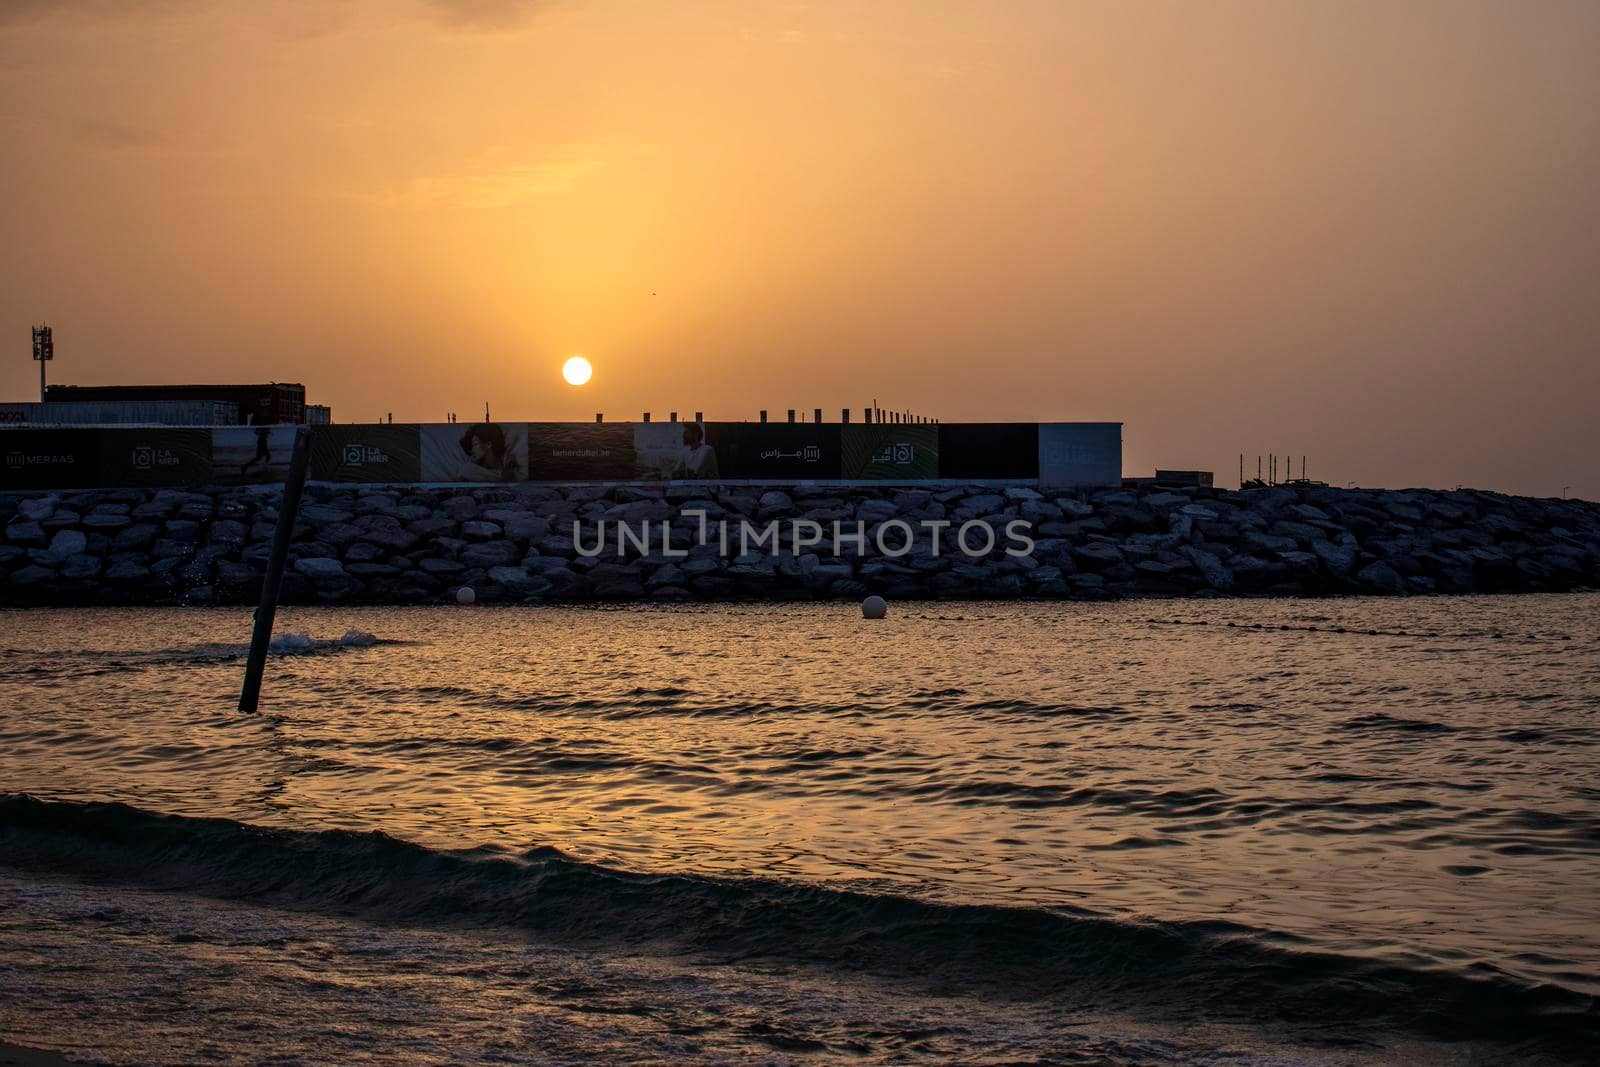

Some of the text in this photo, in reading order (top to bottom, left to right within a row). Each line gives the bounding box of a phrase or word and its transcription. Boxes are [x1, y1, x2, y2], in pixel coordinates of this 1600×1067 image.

[158, 449, 171, 457] LA
[367, 447, 380, 455] LA
[26, 455, 74, 465] MERAAS
[367, 455, 389, 463] MER
